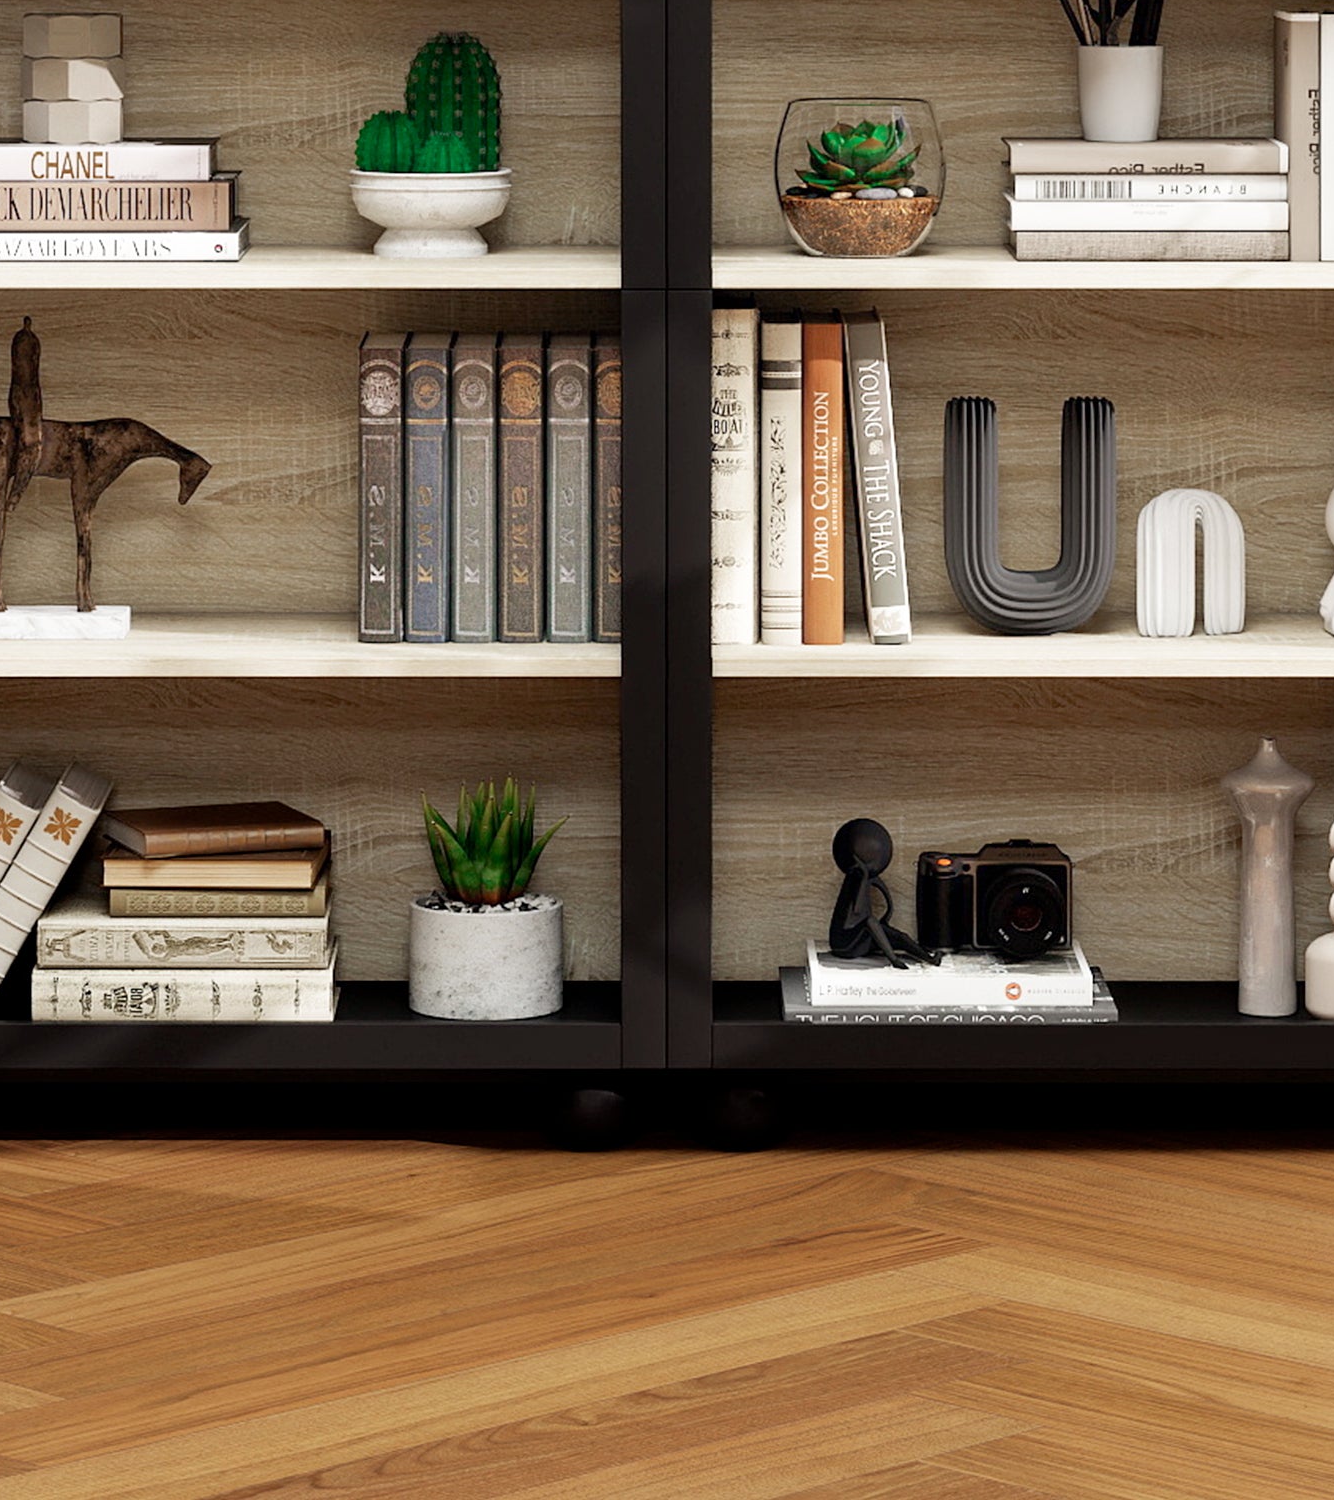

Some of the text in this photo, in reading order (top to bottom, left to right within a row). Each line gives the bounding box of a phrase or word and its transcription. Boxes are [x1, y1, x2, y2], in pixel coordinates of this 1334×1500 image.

[31, 151, 115, 179] CHANEL
[30, 187, 193, 221] DEMARCHELIER
[714, 419, 742, 434] BOAT
[811, 391, 835, 581] JUMBO COLLECTION
[859, 360, 897, 581] YOUNG THE SHACK
